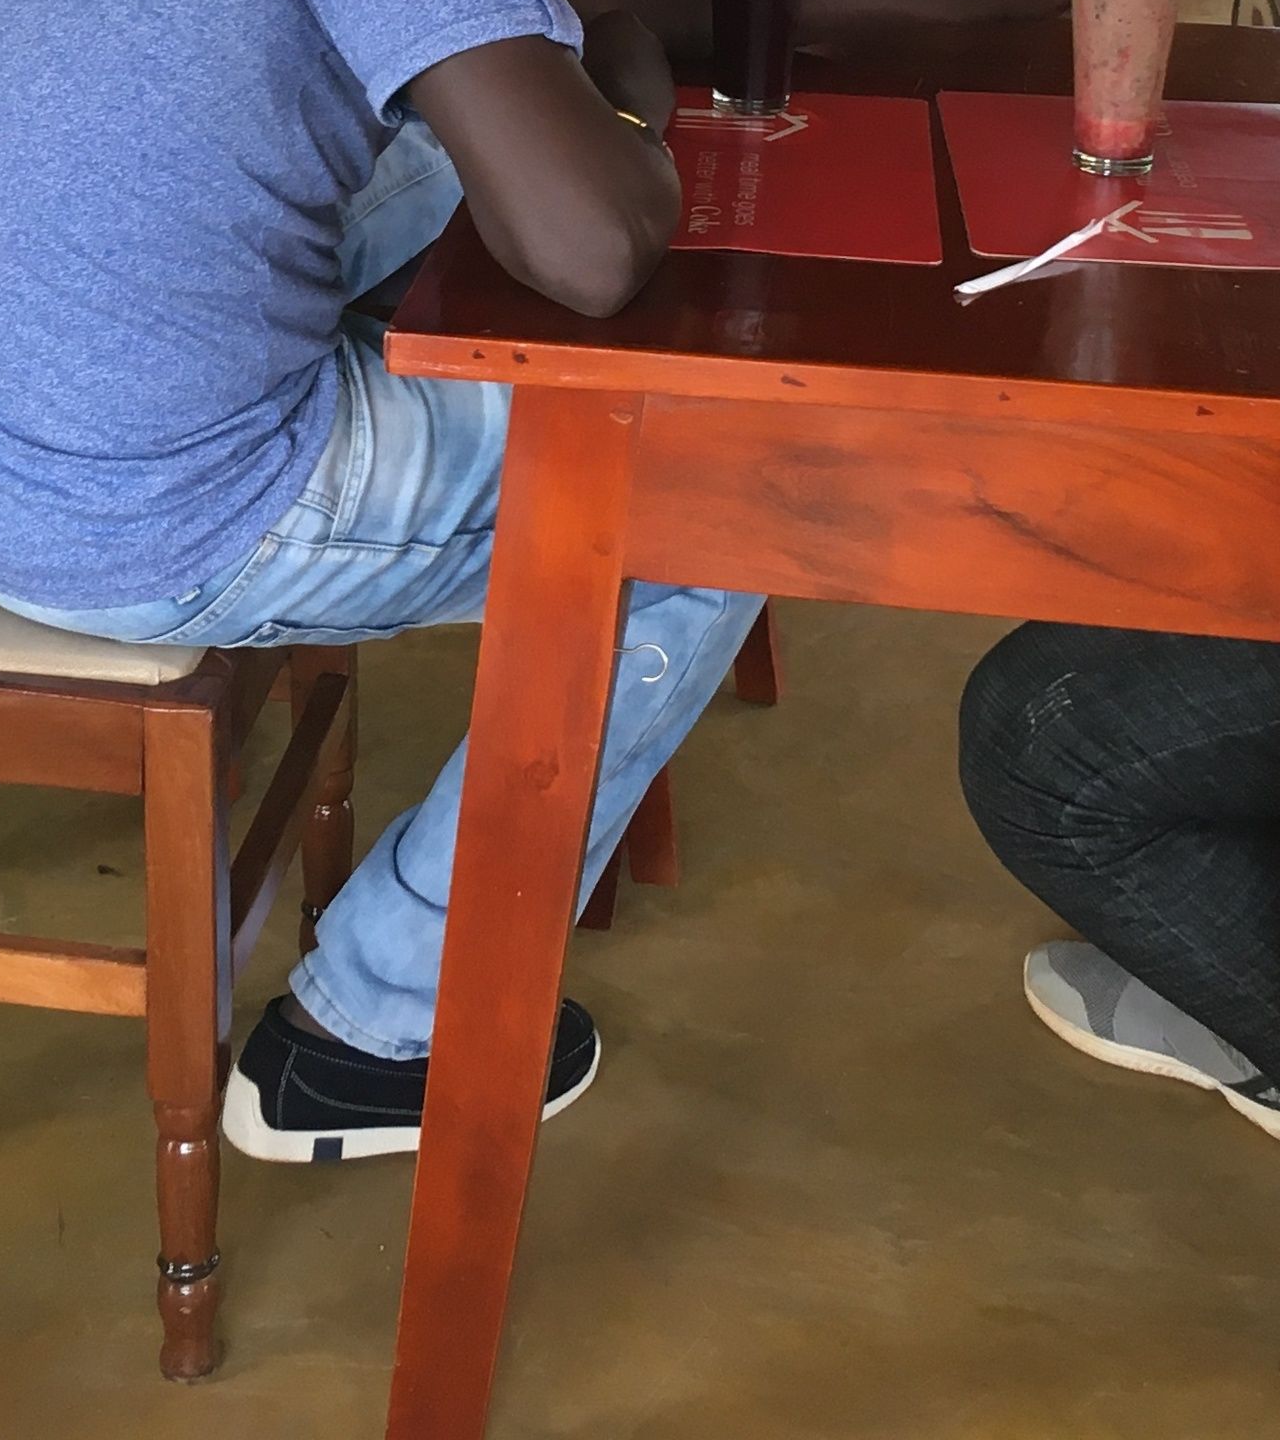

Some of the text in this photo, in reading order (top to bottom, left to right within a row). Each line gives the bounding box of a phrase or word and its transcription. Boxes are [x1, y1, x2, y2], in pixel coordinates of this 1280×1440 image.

[696, 151, 723, 181] better
[687, 205, 722, 235] Coke
[731, 200, 757, 227] goes
